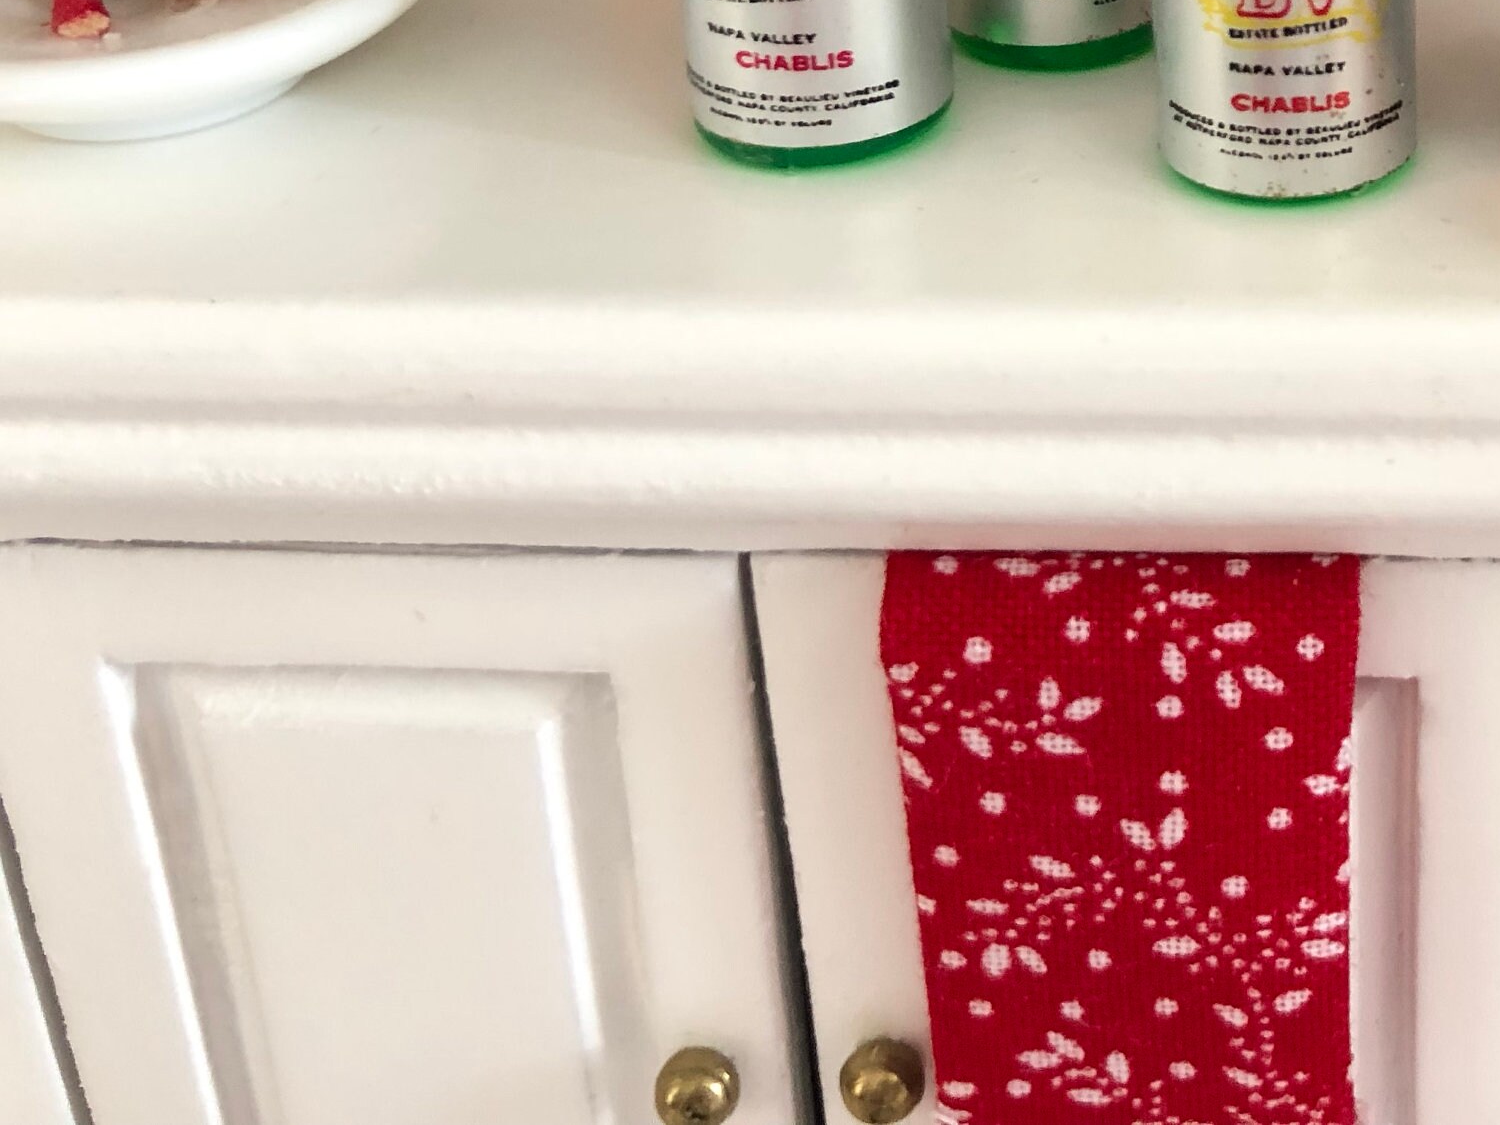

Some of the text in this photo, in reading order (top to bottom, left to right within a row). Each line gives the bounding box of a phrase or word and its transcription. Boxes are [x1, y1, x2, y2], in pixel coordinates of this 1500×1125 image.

[750, 32, 818, 45] VALLEY
[735, 49, 855, 72] CHABLIS
[1228, 60, 1347, 76] NAPA VALLEY
[1230, 90, 1351, 114] CHABLIS
